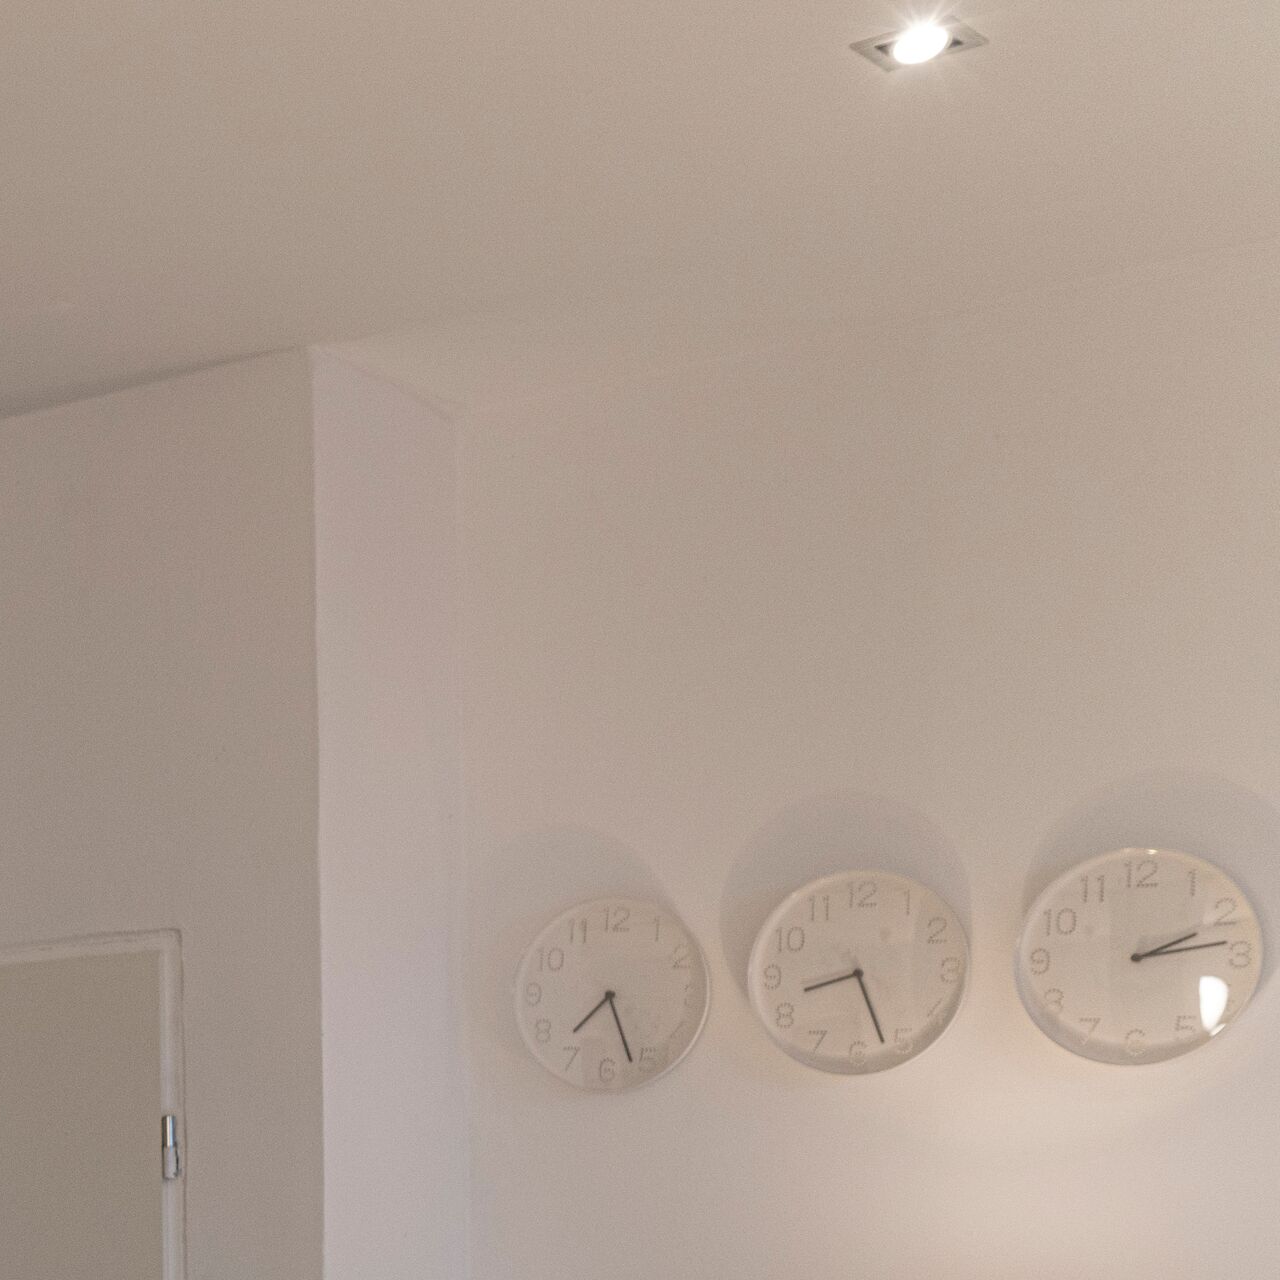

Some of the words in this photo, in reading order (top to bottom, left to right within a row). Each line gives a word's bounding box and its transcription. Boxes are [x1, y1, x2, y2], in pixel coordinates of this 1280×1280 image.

[1124, 859, 1158, 888] 12
[1187, 868, 1197, 897] 1
[848, 881, 877, 908] 12
[903, 889, 911, 916] 1
[1080, 875, 1105, 903] 11
[604, 906, 630, 933] 12
[809, 895, 829, 921] 11
[1043, 907, 1077, 936] 10
[1213, 897, 1238, 927] 2
[568, 918, 588, 944] 11
[653, 916, 661, 942] 1
[775, 926, 805, 953] 10
[927, 917, 948, 944] 2
[538, 947, 564, 972] 10
[1029, 947, 1051, 976] 9
[1229, 940, 1252, 969] 3
[764, 963, 781, 990] 9
[775, 1002, 795, 1029] 8
[809, 1029, 828, 1055] 7
[599, 1057, 615, 1083] 6
